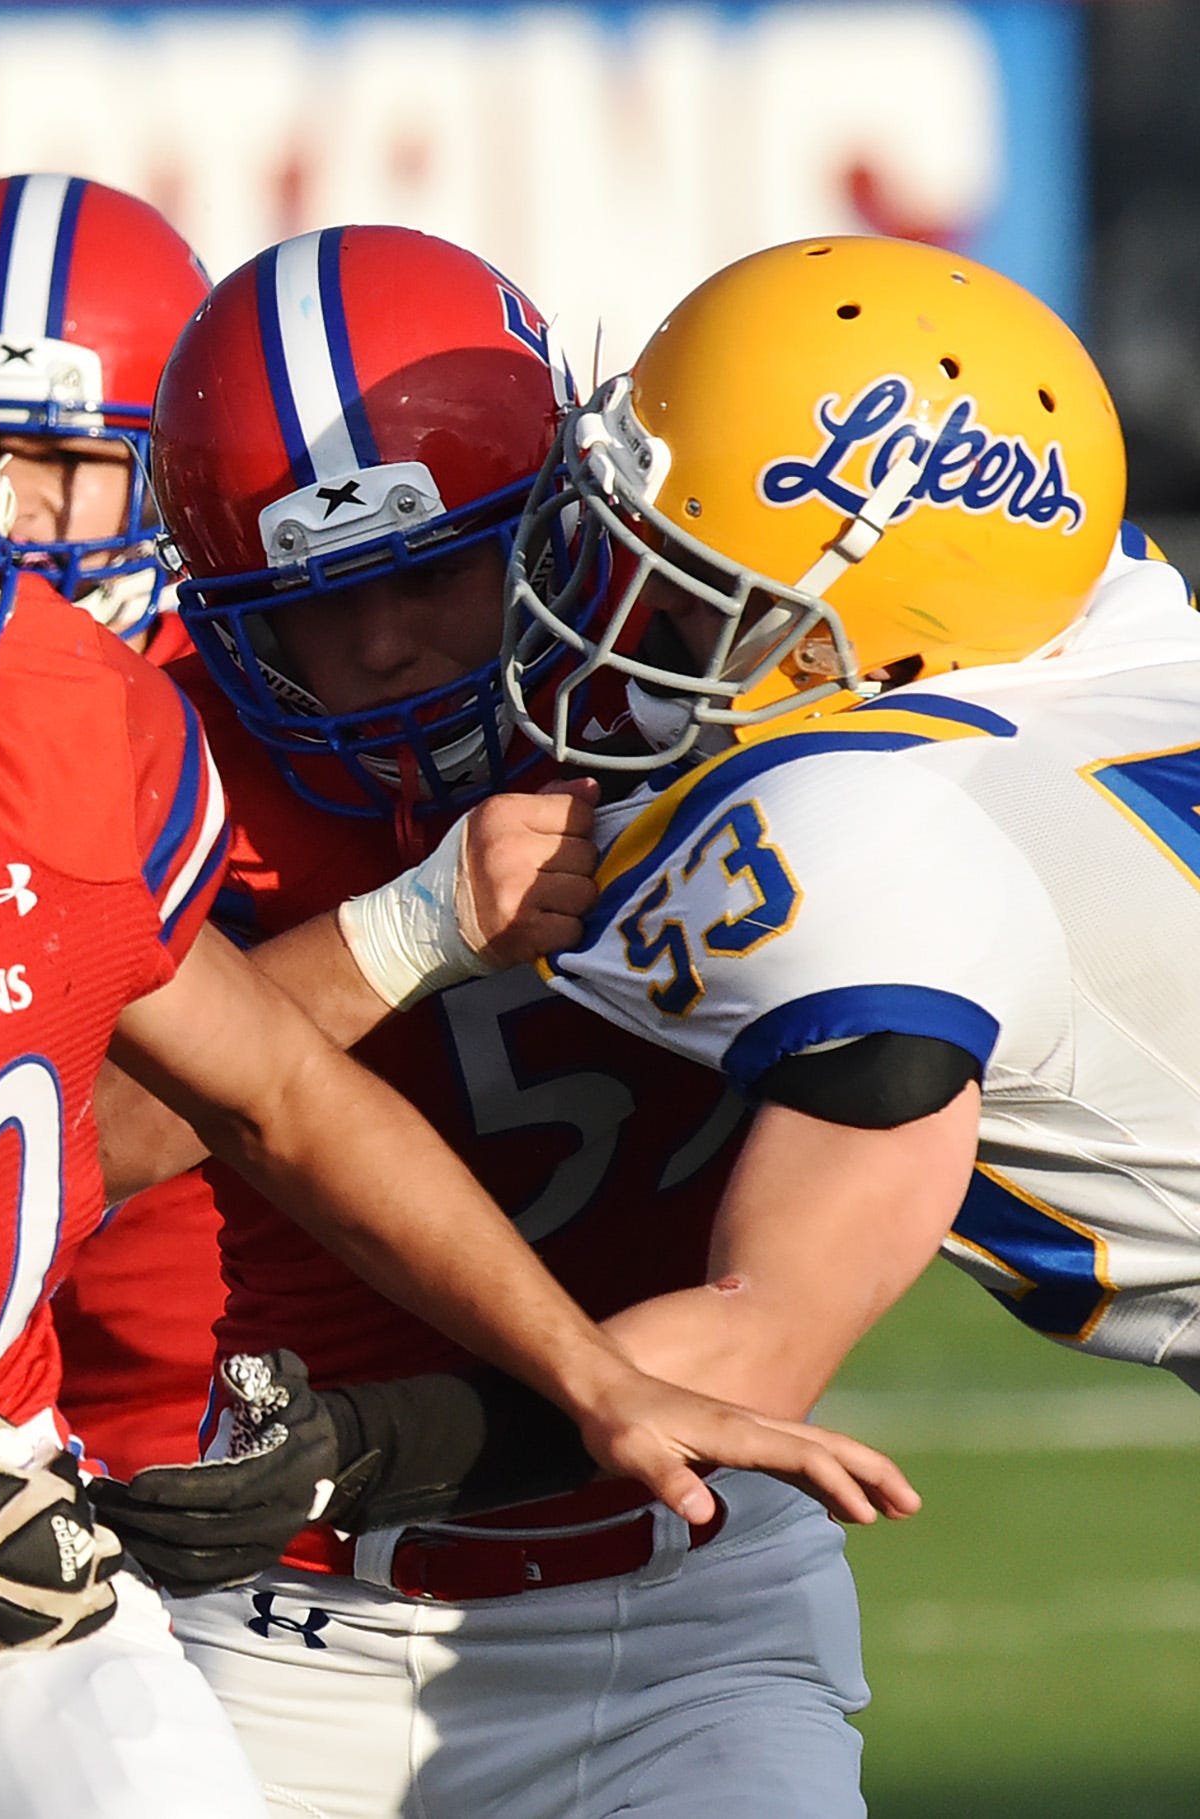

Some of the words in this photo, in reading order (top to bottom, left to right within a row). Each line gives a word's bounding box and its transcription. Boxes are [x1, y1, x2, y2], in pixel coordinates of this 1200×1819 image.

[758, 375, 1083, 534] Lakers
[226, 642, 318, 708] XNITH
[618, 798, 803, 1017] 53
[50, 1514, 77, 1582] adidas
